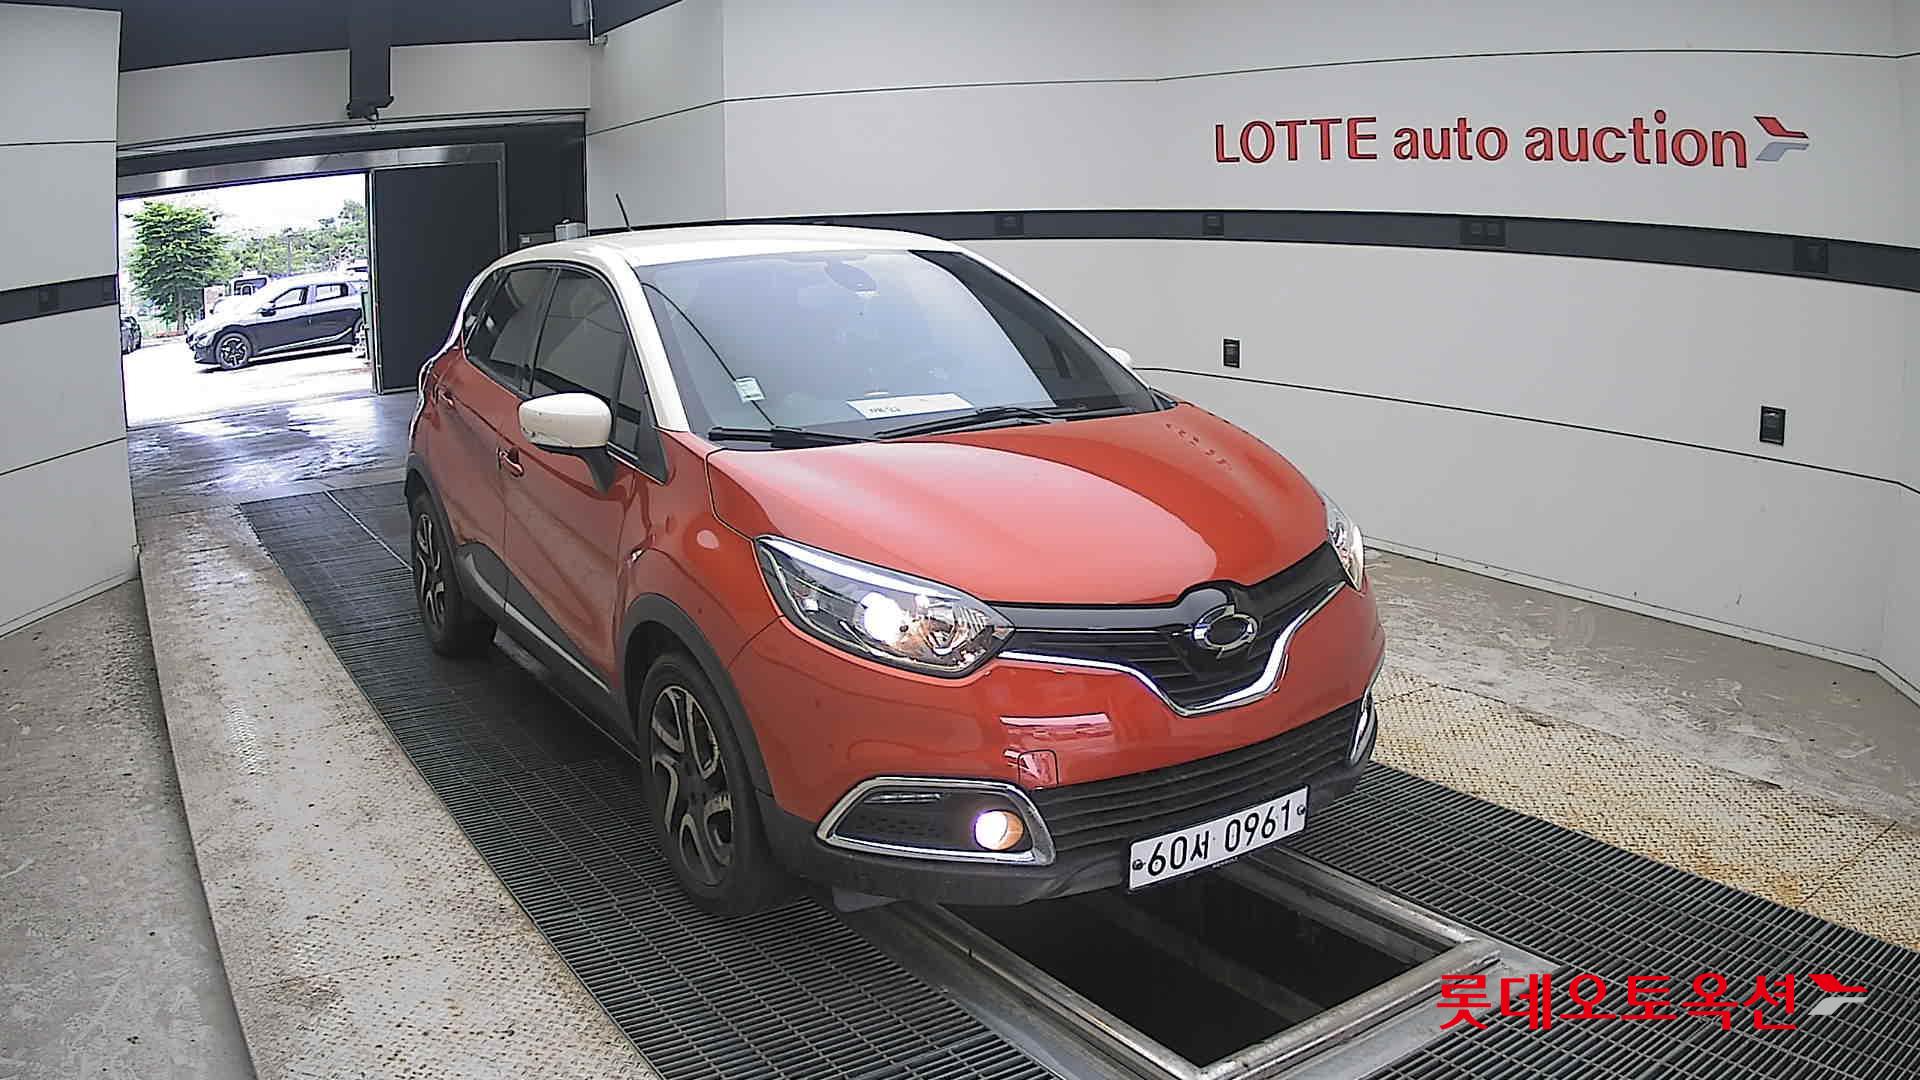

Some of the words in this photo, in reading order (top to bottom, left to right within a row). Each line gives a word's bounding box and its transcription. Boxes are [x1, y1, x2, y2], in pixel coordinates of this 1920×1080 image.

[1215, 116, 1378, 164] LOTTE
[1392, 117, 1509, 162] auto
[1524, 109, 1749, 169] auction
[1147, 830, 1210, 877] 60서
[1224, 799, 1291, 853] 0961
